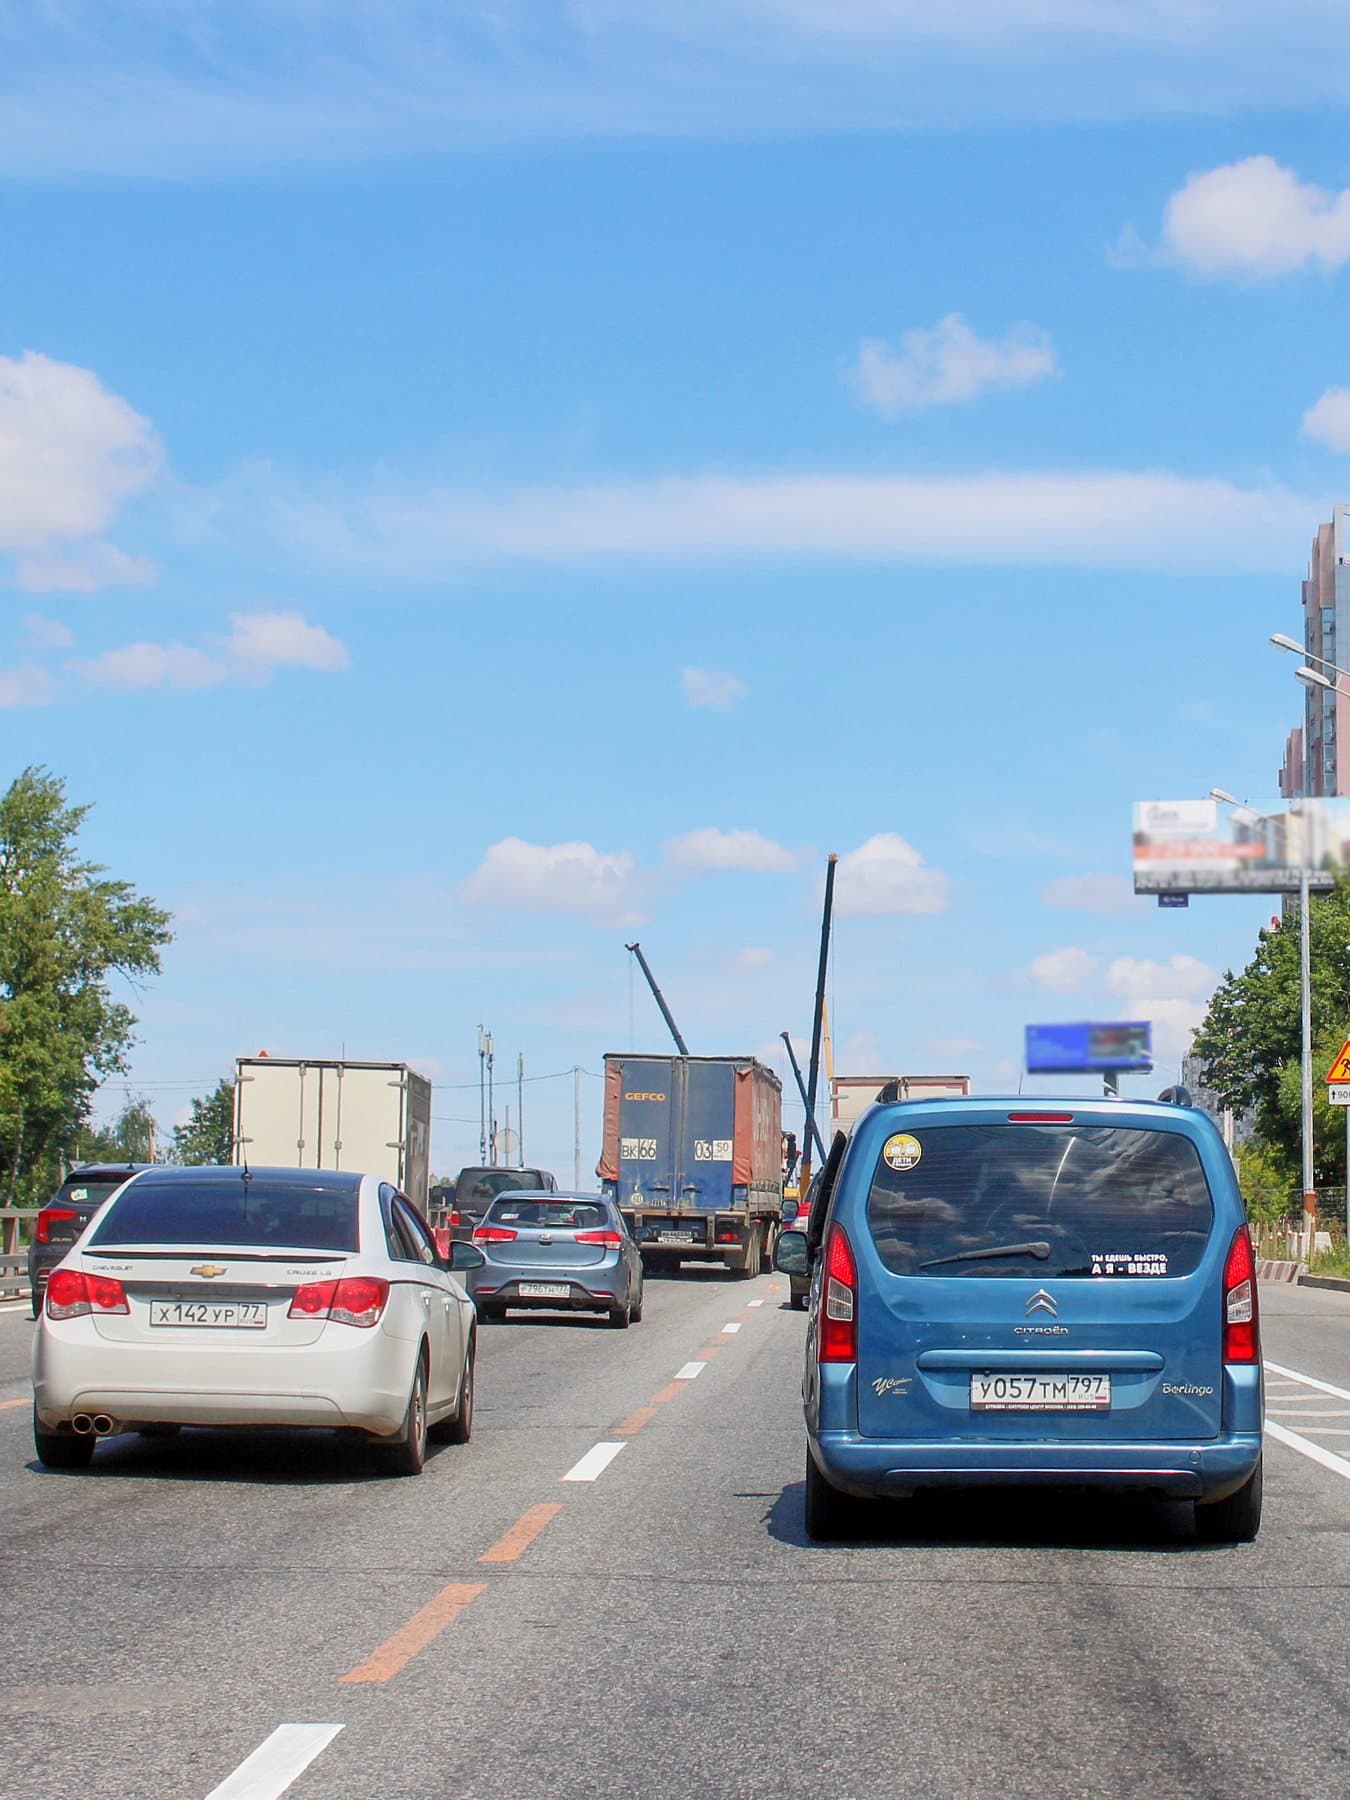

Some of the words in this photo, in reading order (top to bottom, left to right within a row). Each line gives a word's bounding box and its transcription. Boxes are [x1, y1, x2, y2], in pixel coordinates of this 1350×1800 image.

[624, 1092, 666, 1101] GEFCO
[1091, 1254, 1104, 1262] ТЫ
[1105, 1254, 1133, 1262] ЕДЕШЬ
[1134, 1254, 1168, 1262] БЫСТРО,
[1091, 1263, 1102, 1274] А
[1105, 1263, 1114, 1274] Я
[1127, 1262, 1167, 1275] ВЕЗДЕ
[1069, 1377, 1103, 1393] 797
[1162, 1383, 1214, 1396] Berlingo
